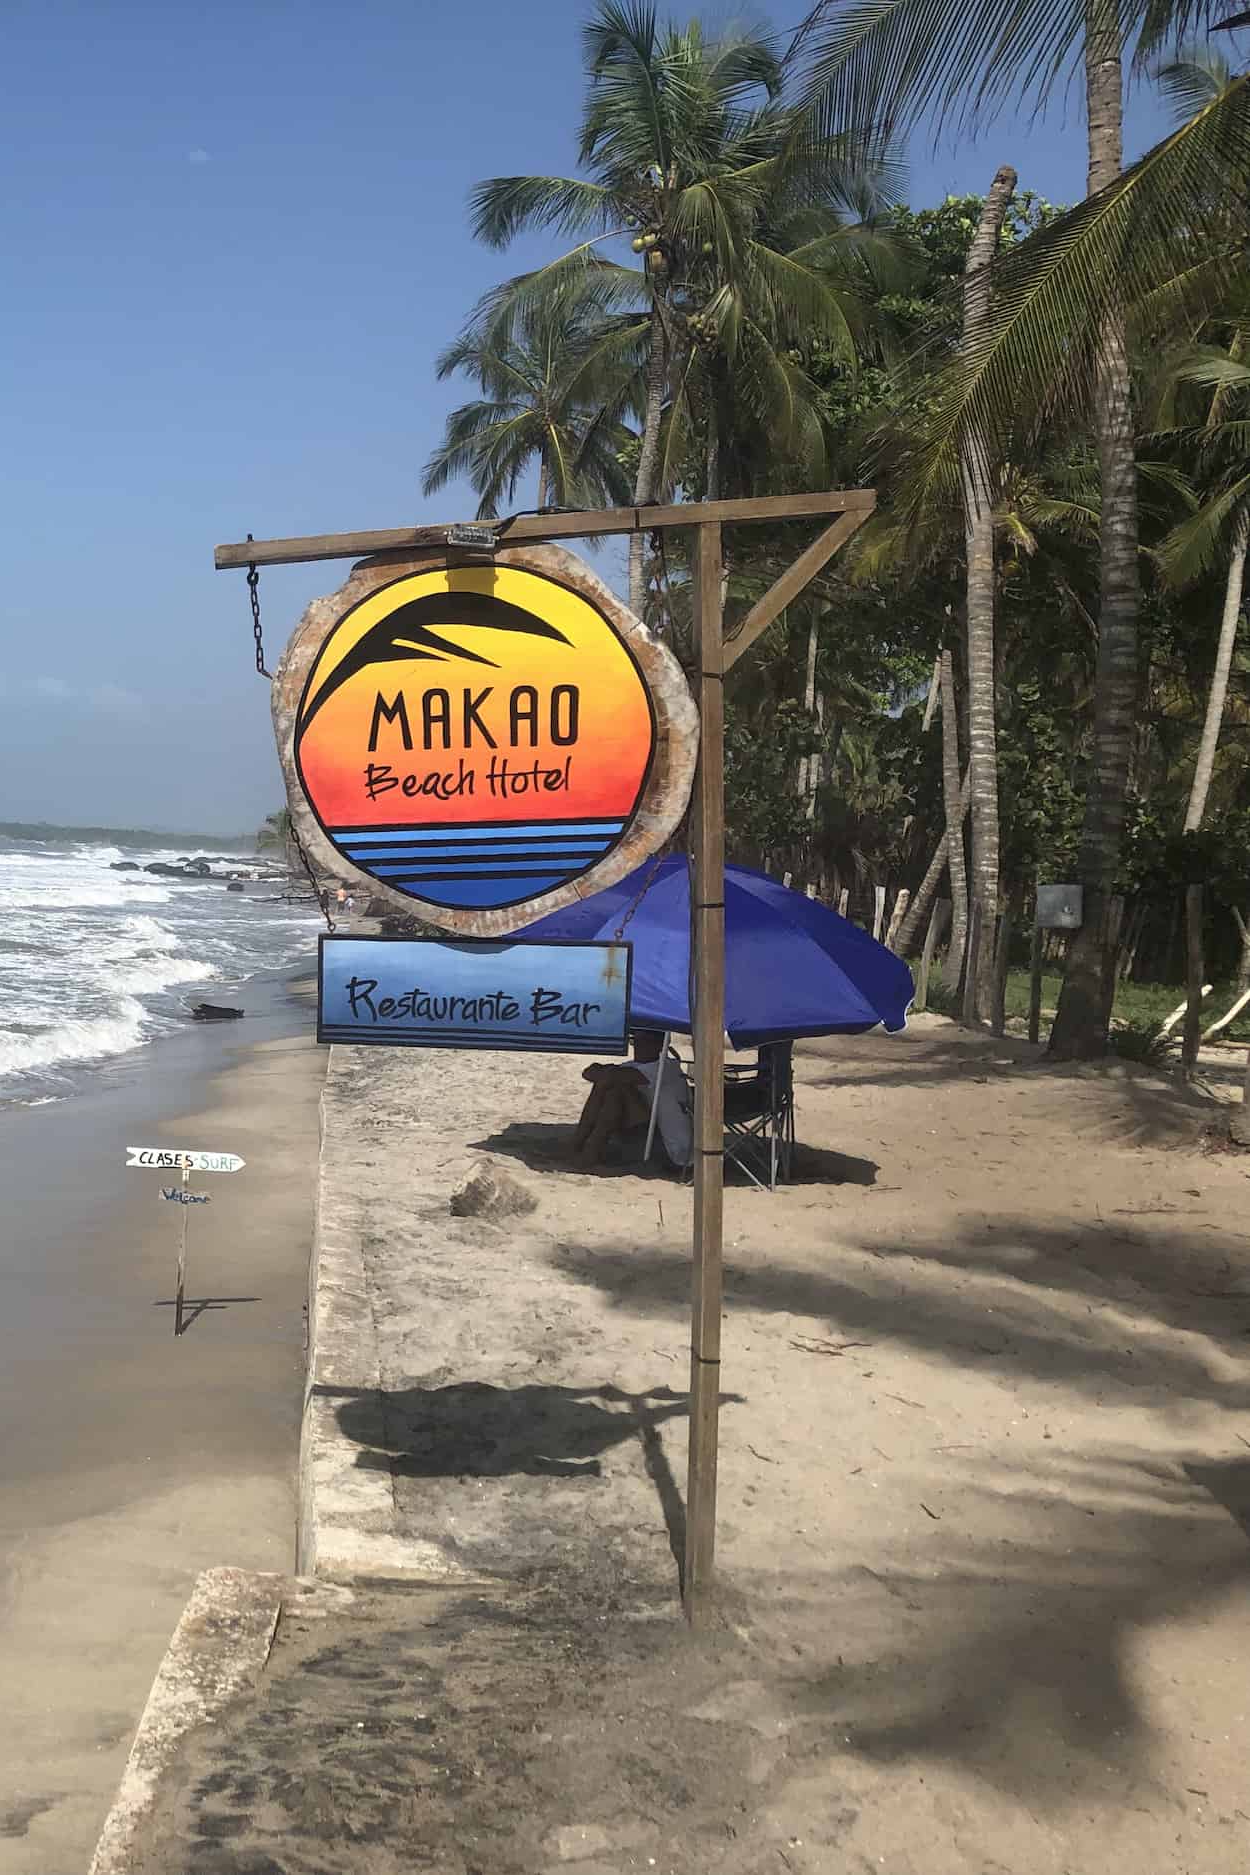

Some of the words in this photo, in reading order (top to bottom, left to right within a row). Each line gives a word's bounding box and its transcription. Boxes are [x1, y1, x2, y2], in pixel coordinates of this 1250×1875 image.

[368, 684, 580, 752] MAKAO
[364, 758, 475, 801] Beach
[485, 755, 572, 797] Hotel
[346, 976, 520, 1023] Restaurante
[530, 987, 601, 1027] Bar
[139, 1151, 194, 1167] CLASES
